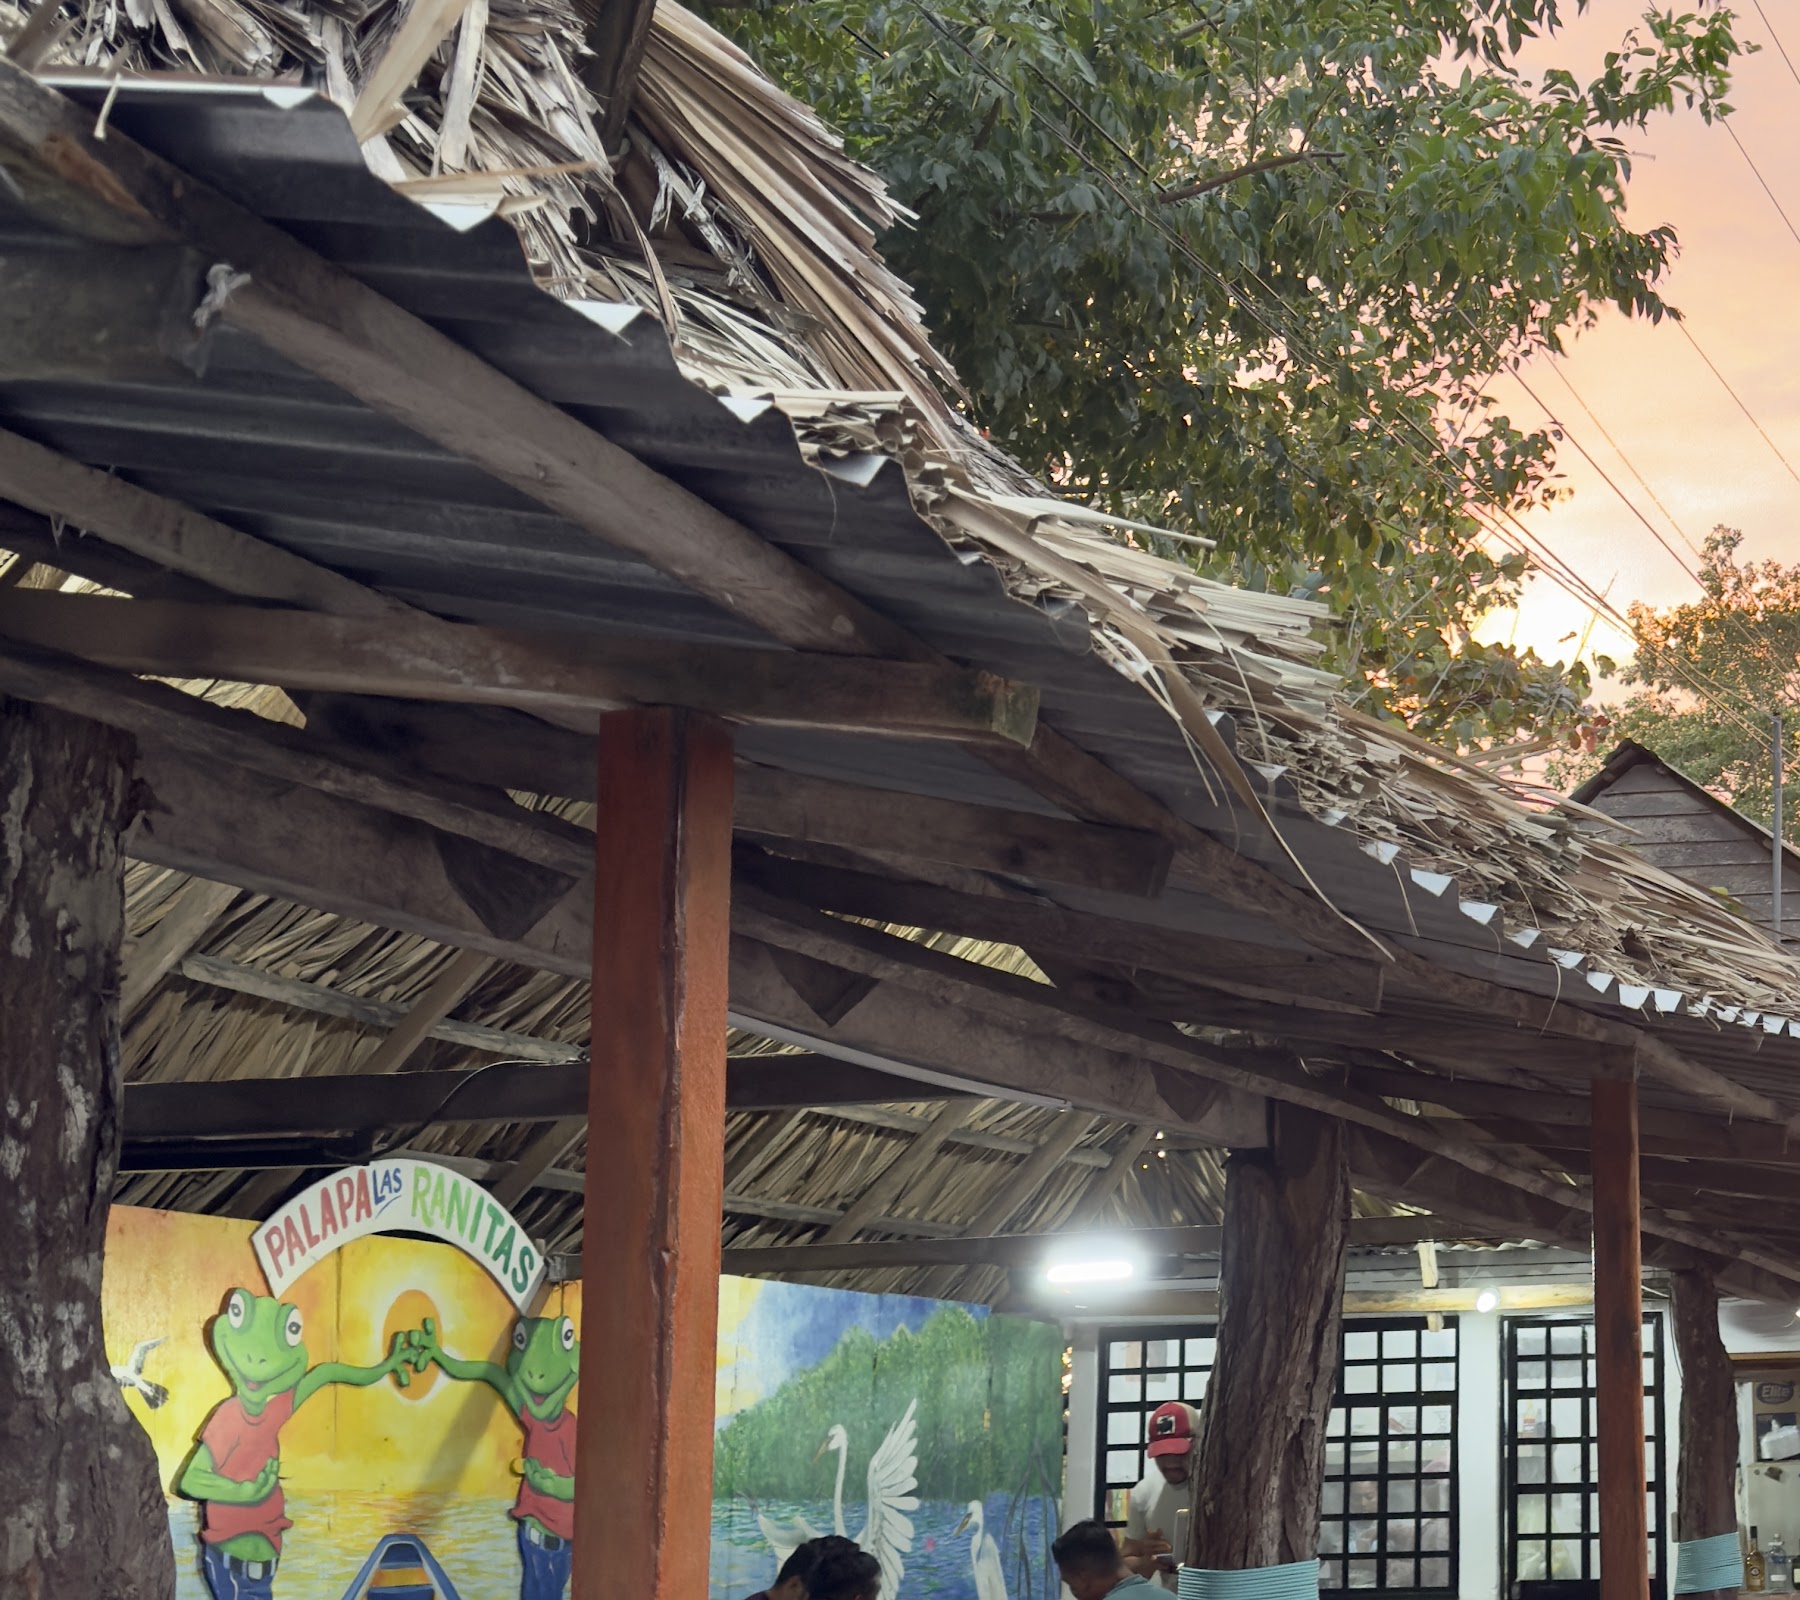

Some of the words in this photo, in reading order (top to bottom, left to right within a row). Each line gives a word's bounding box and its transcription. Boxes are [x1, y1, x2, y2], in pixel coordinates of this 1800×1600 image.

[264, 1168, 372, 1279] PALAPA
[372, 1167, 403, 1205] LAS
[411, 1166, 535, 1294] RANITAS
